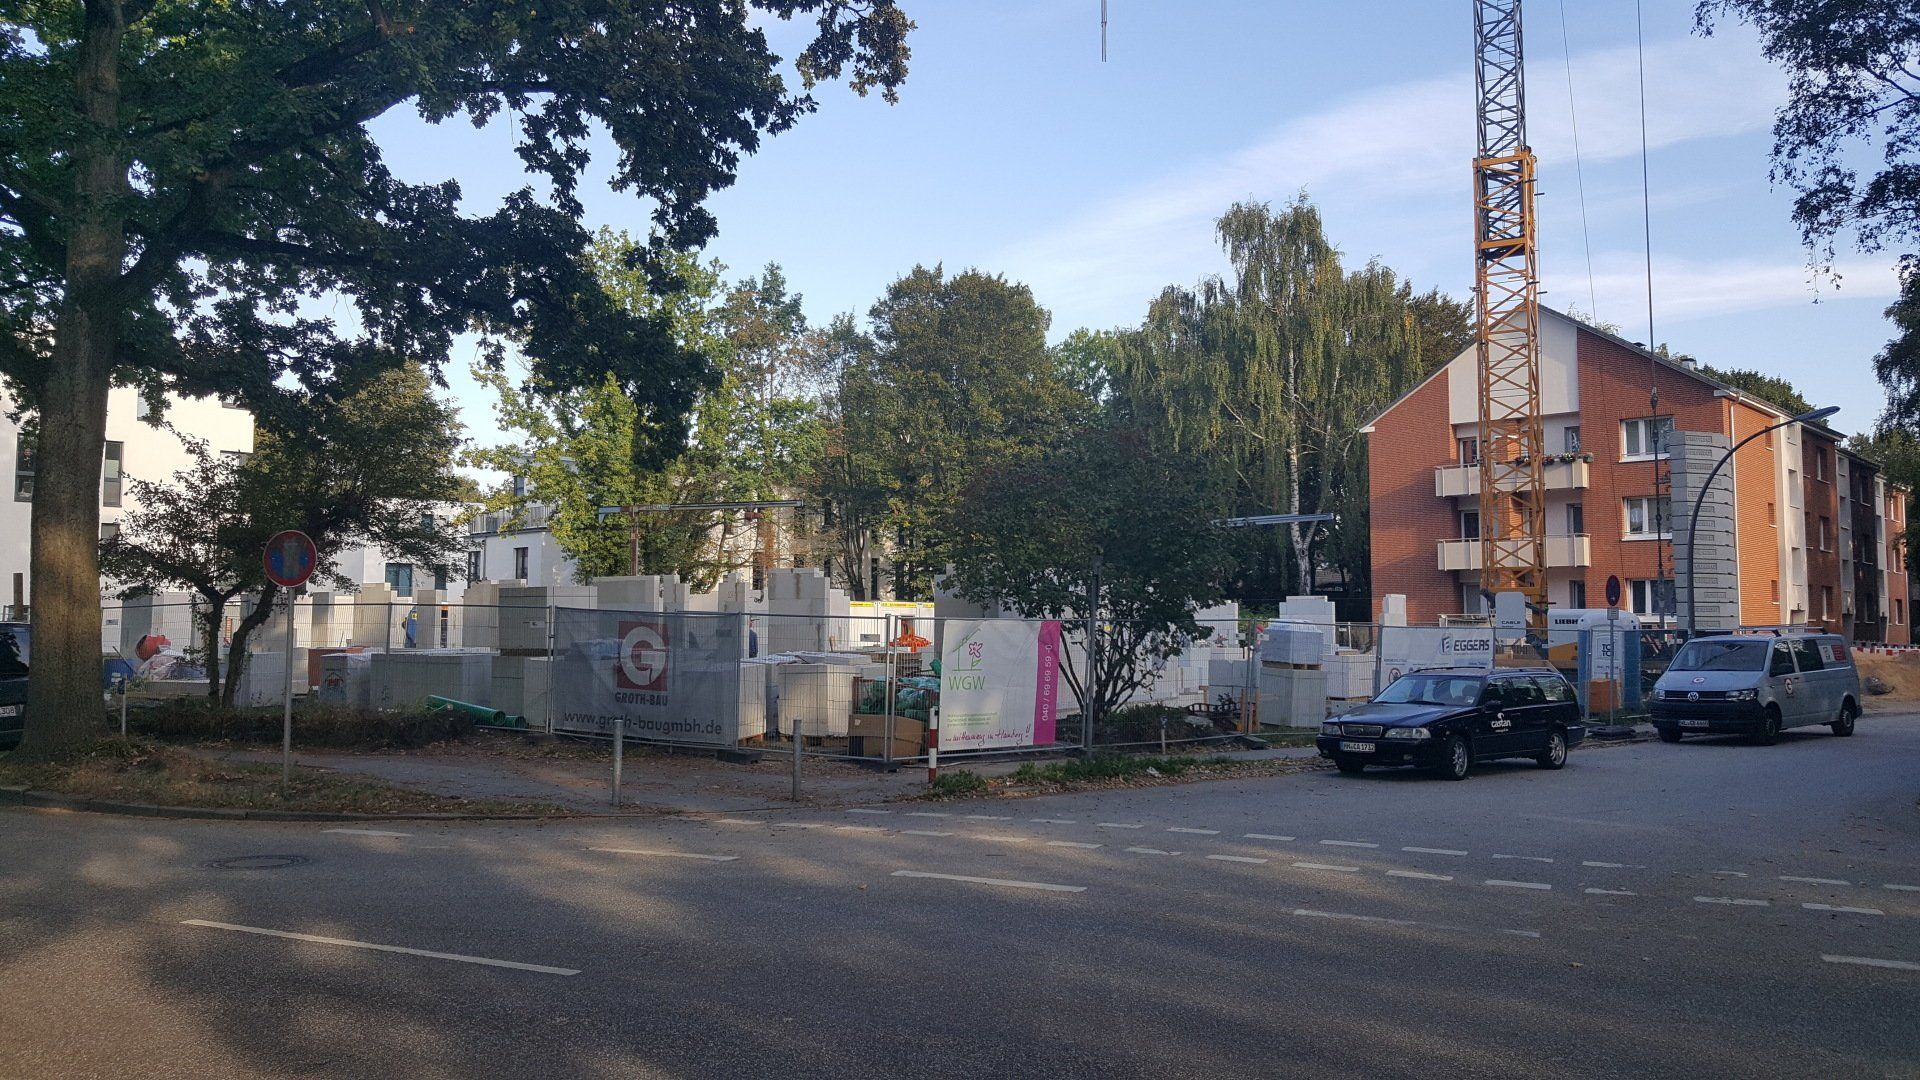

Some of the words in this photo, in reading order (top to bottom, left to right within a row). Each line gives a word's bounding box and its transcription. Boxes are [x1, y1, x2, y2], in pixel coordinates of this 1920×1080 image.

[1454, 640, 1490, 652] EGGERS
[949, 676, 986, 690] WGW
[614, 692, 668, 706] GROTH-BAU
